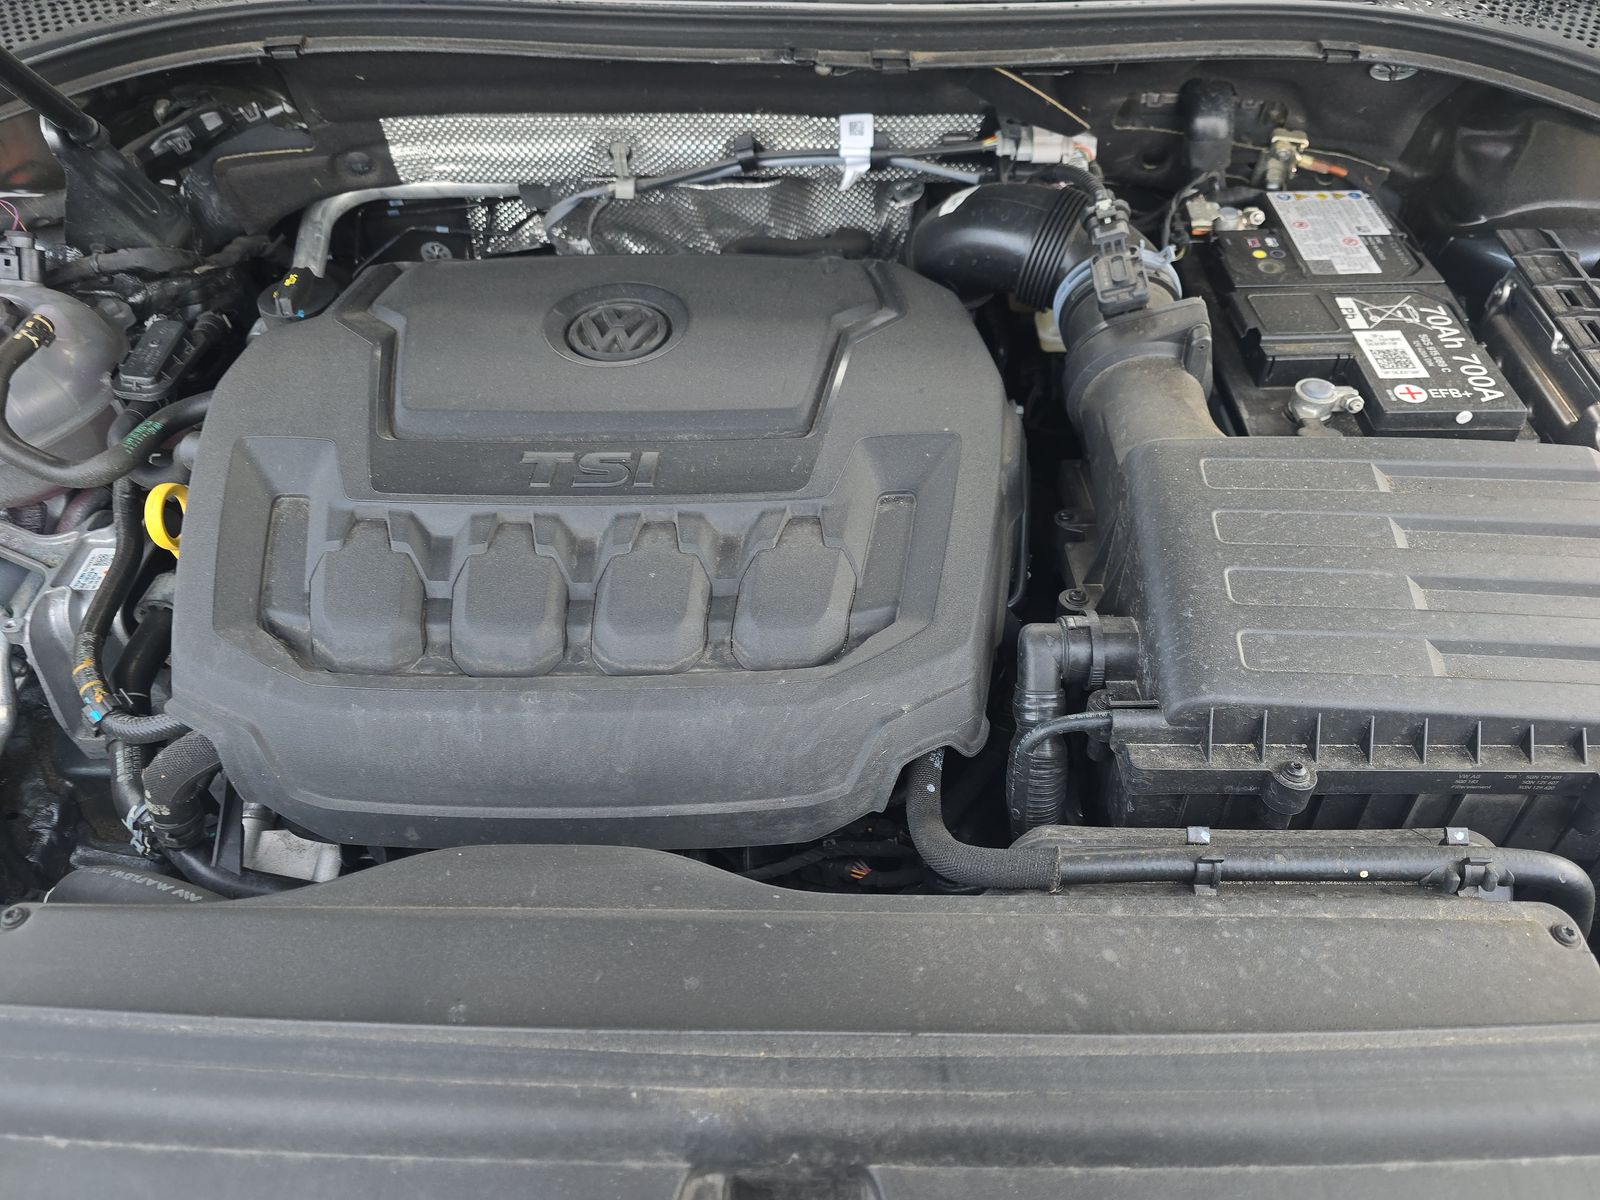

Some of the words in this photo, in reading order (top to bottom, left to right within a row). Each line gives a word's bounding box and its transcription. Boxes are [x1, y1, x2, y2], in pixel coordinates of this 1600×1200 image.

[1419, 305, 1466, 349] 70Ah
[1452, 353, 1505, 403] 700A
[1428, 388, 1473, 399] EFB+
[520, 451, 660, 488] TSI
